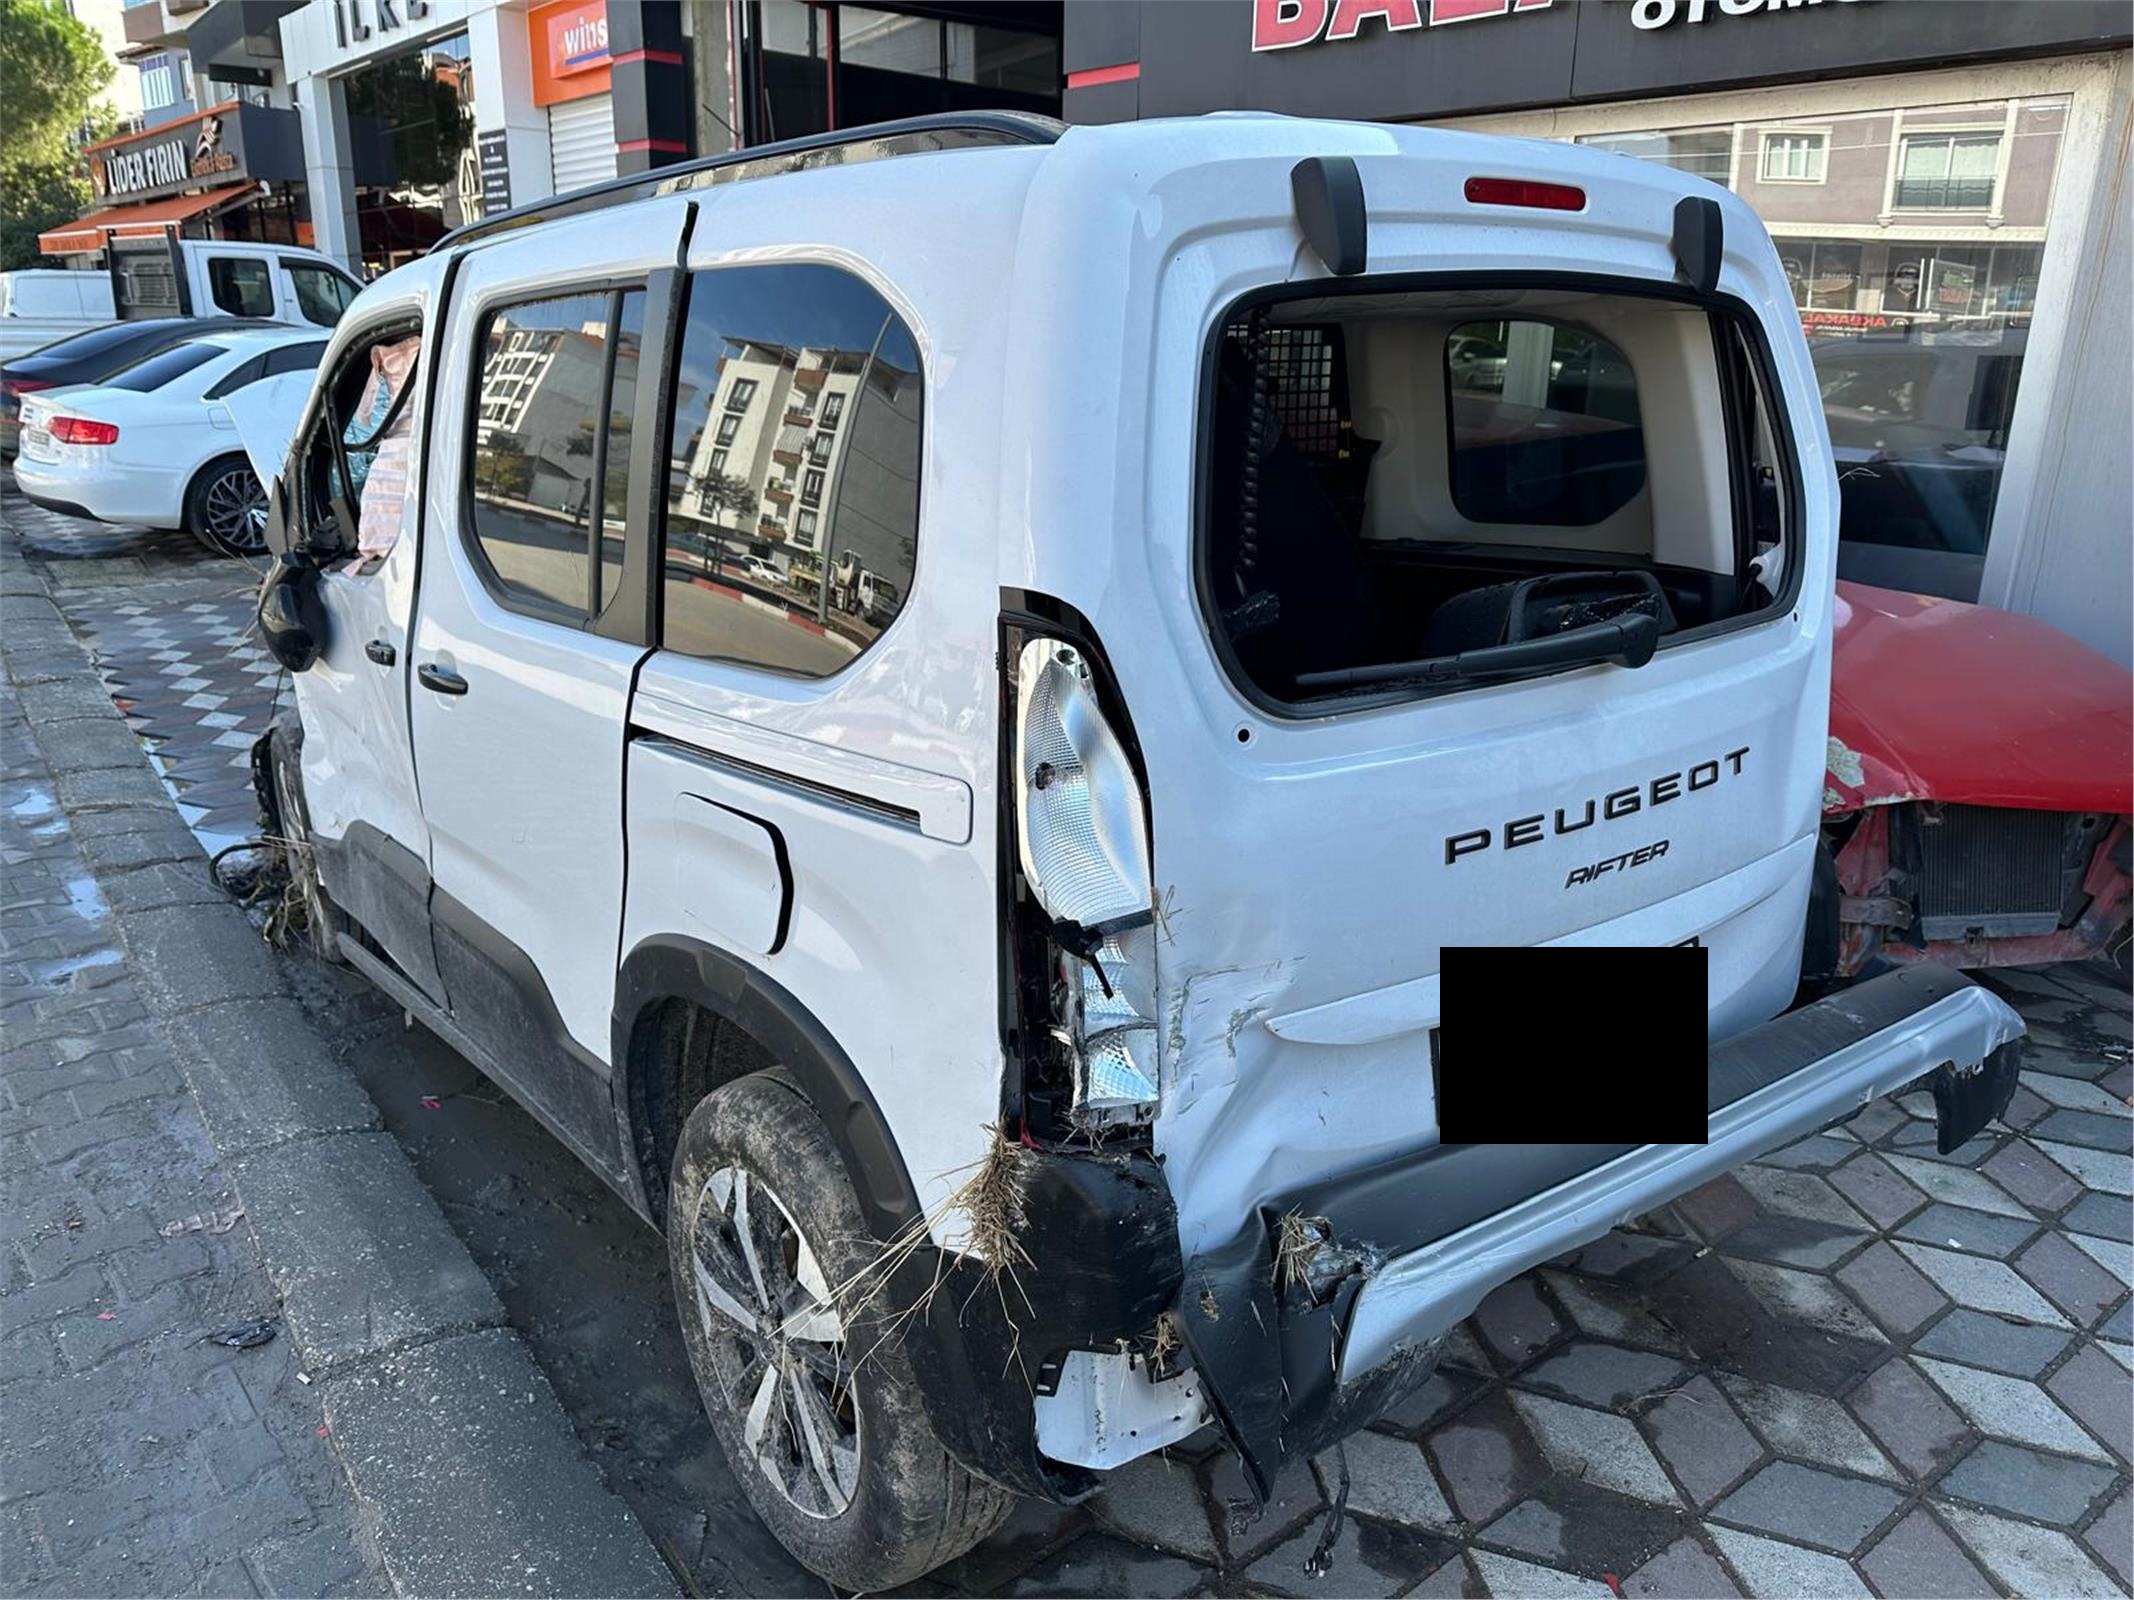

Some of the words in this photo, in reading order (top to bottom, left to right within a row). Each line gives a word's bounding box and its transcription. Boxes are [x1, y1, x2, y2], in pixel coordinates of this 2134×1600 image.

[106, 149, 147, 195] LİDER
[144, 140, 188, 188] FIRIN
[1445, 746, 1750, 865] PEUGEOT
[1564, 839, 1670, 889] RIFTER
